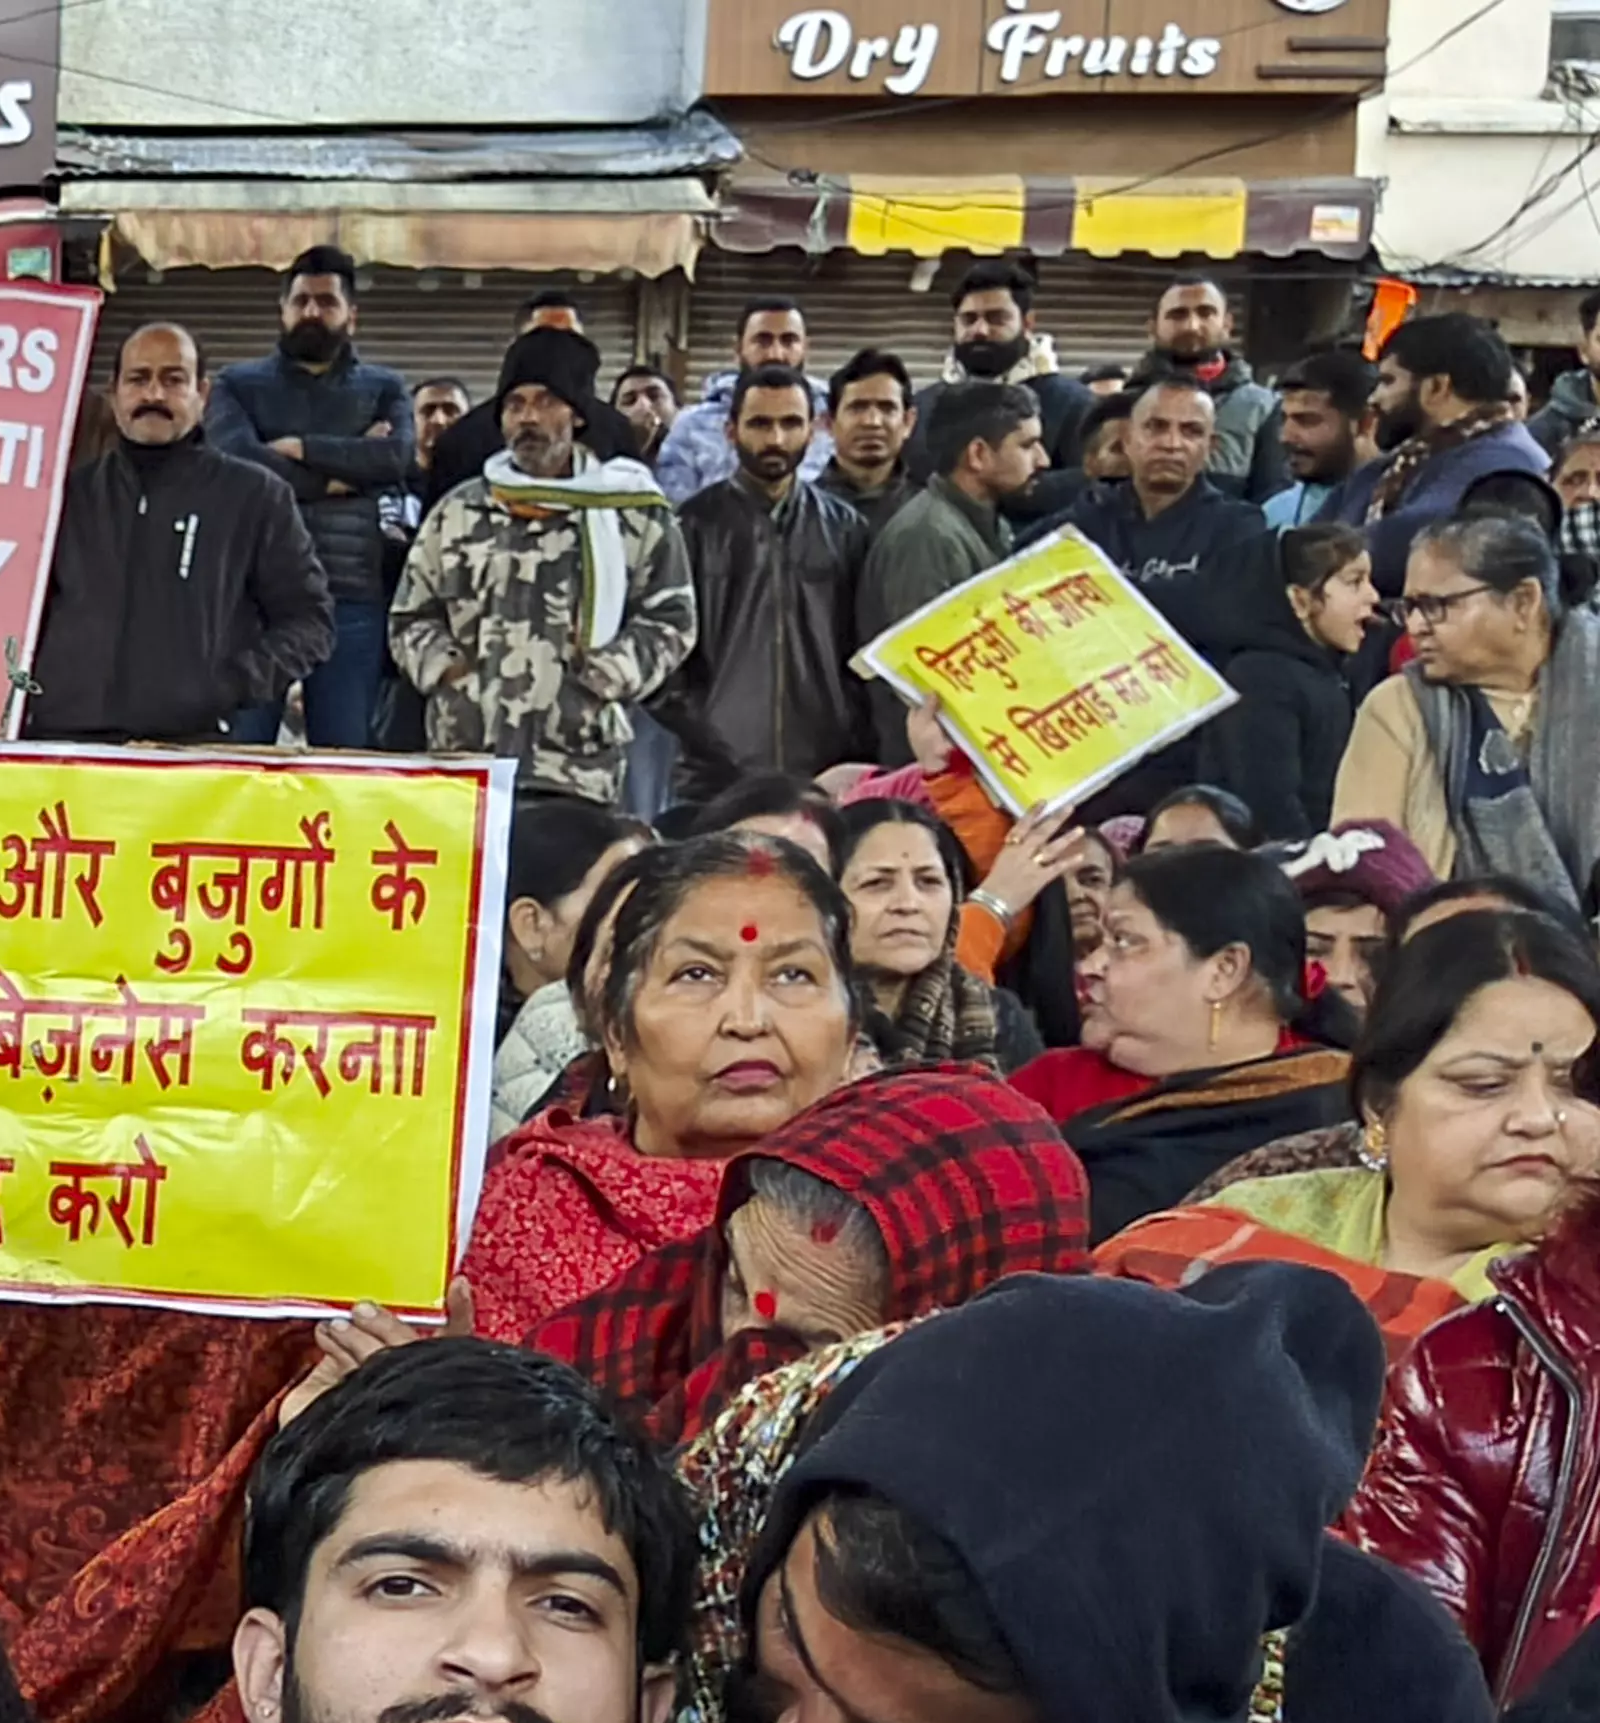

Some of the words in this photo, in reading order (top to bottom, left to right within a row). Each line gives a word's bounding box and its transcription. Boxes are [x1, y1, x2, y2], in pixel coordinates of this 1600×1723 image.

[778, 10, 939, 94] Dry
[987, 10, 1221, 82] Fruits
[151, 811, 335, 973] बुजुर्गों
[371, 819, 438, 930] के
[49, 1133, 167, 1249] करो
